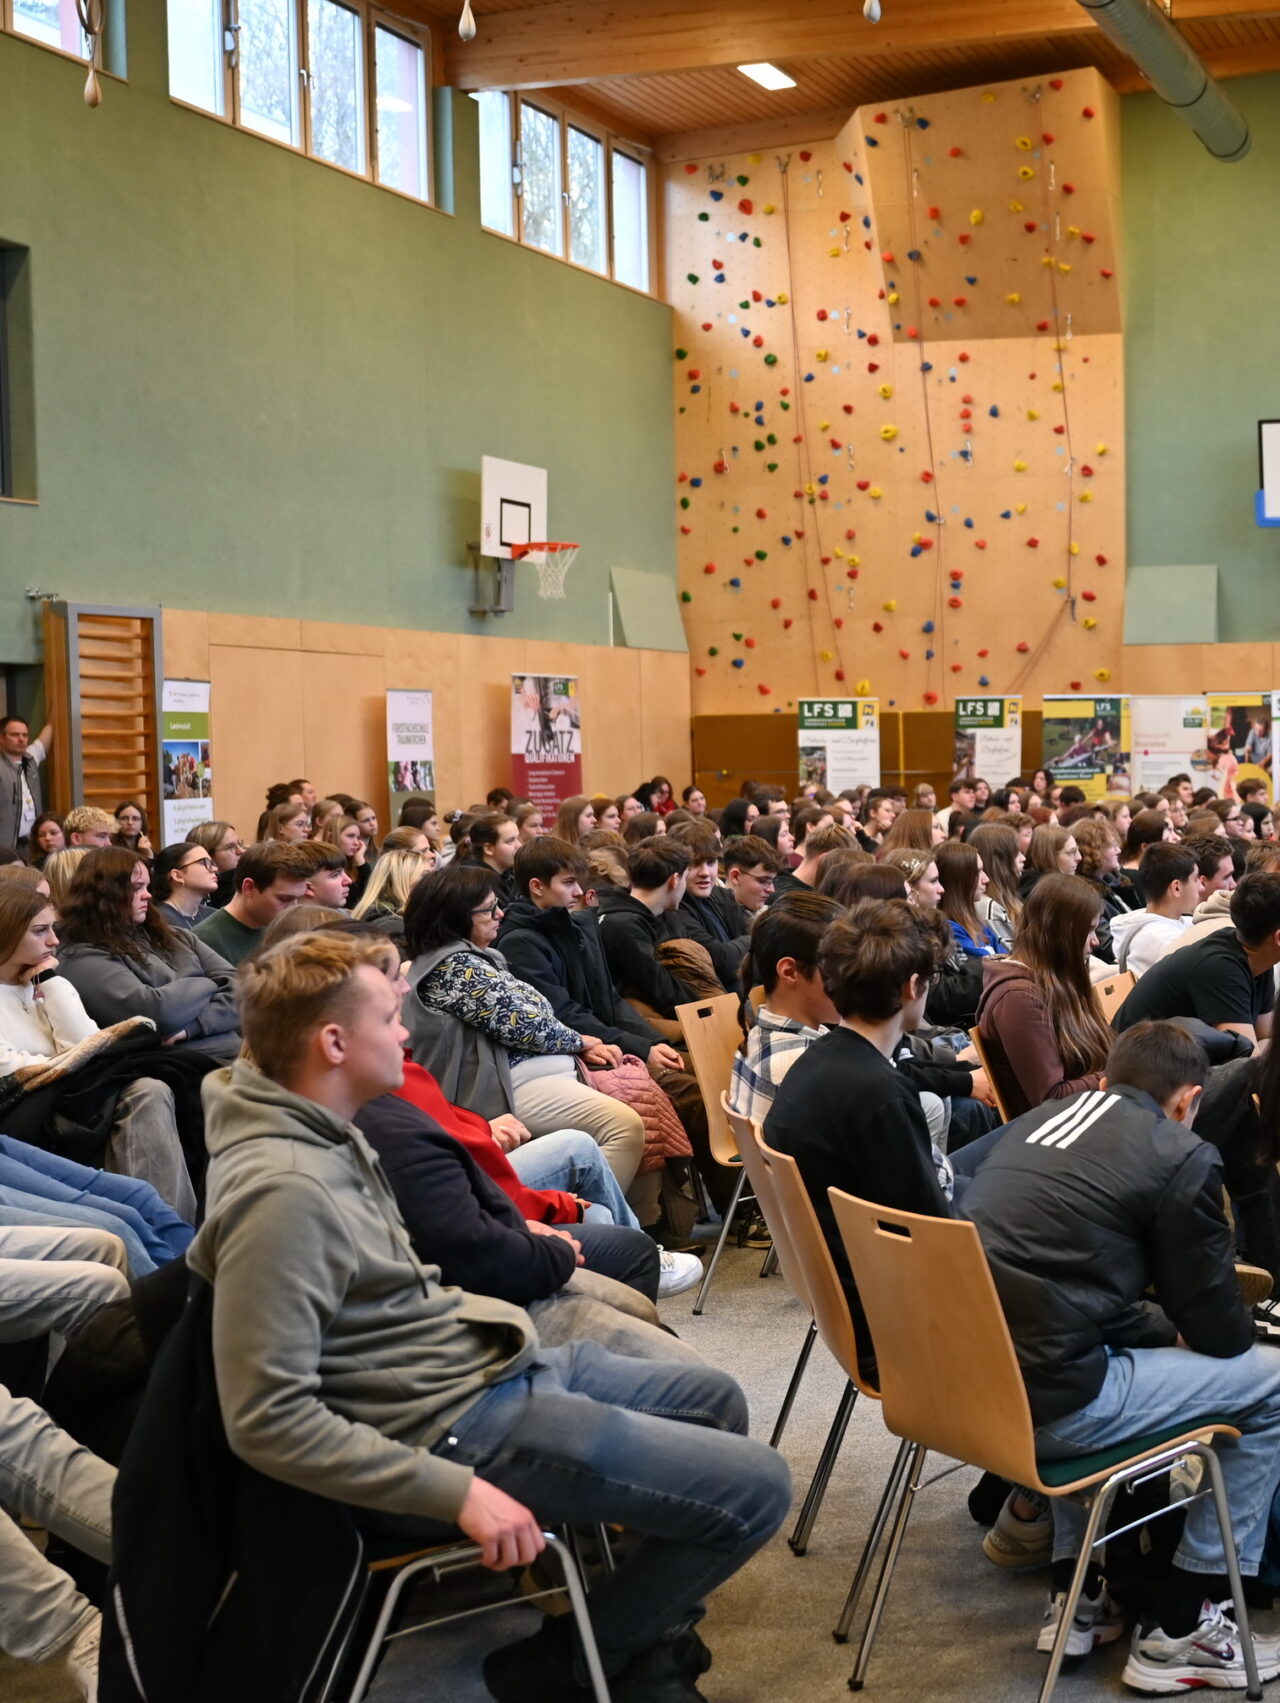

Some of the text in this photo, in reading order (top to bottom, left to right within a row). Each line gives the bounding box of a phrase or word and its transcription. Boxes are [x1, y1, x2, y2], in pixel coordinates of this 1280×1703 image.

[803, 704, 834, 717] LFS
[959, 702, 985, 716] LFS
[1096, 703, 1111, 711] LFS
[525, 730, 574, 753] ZUSATZ
